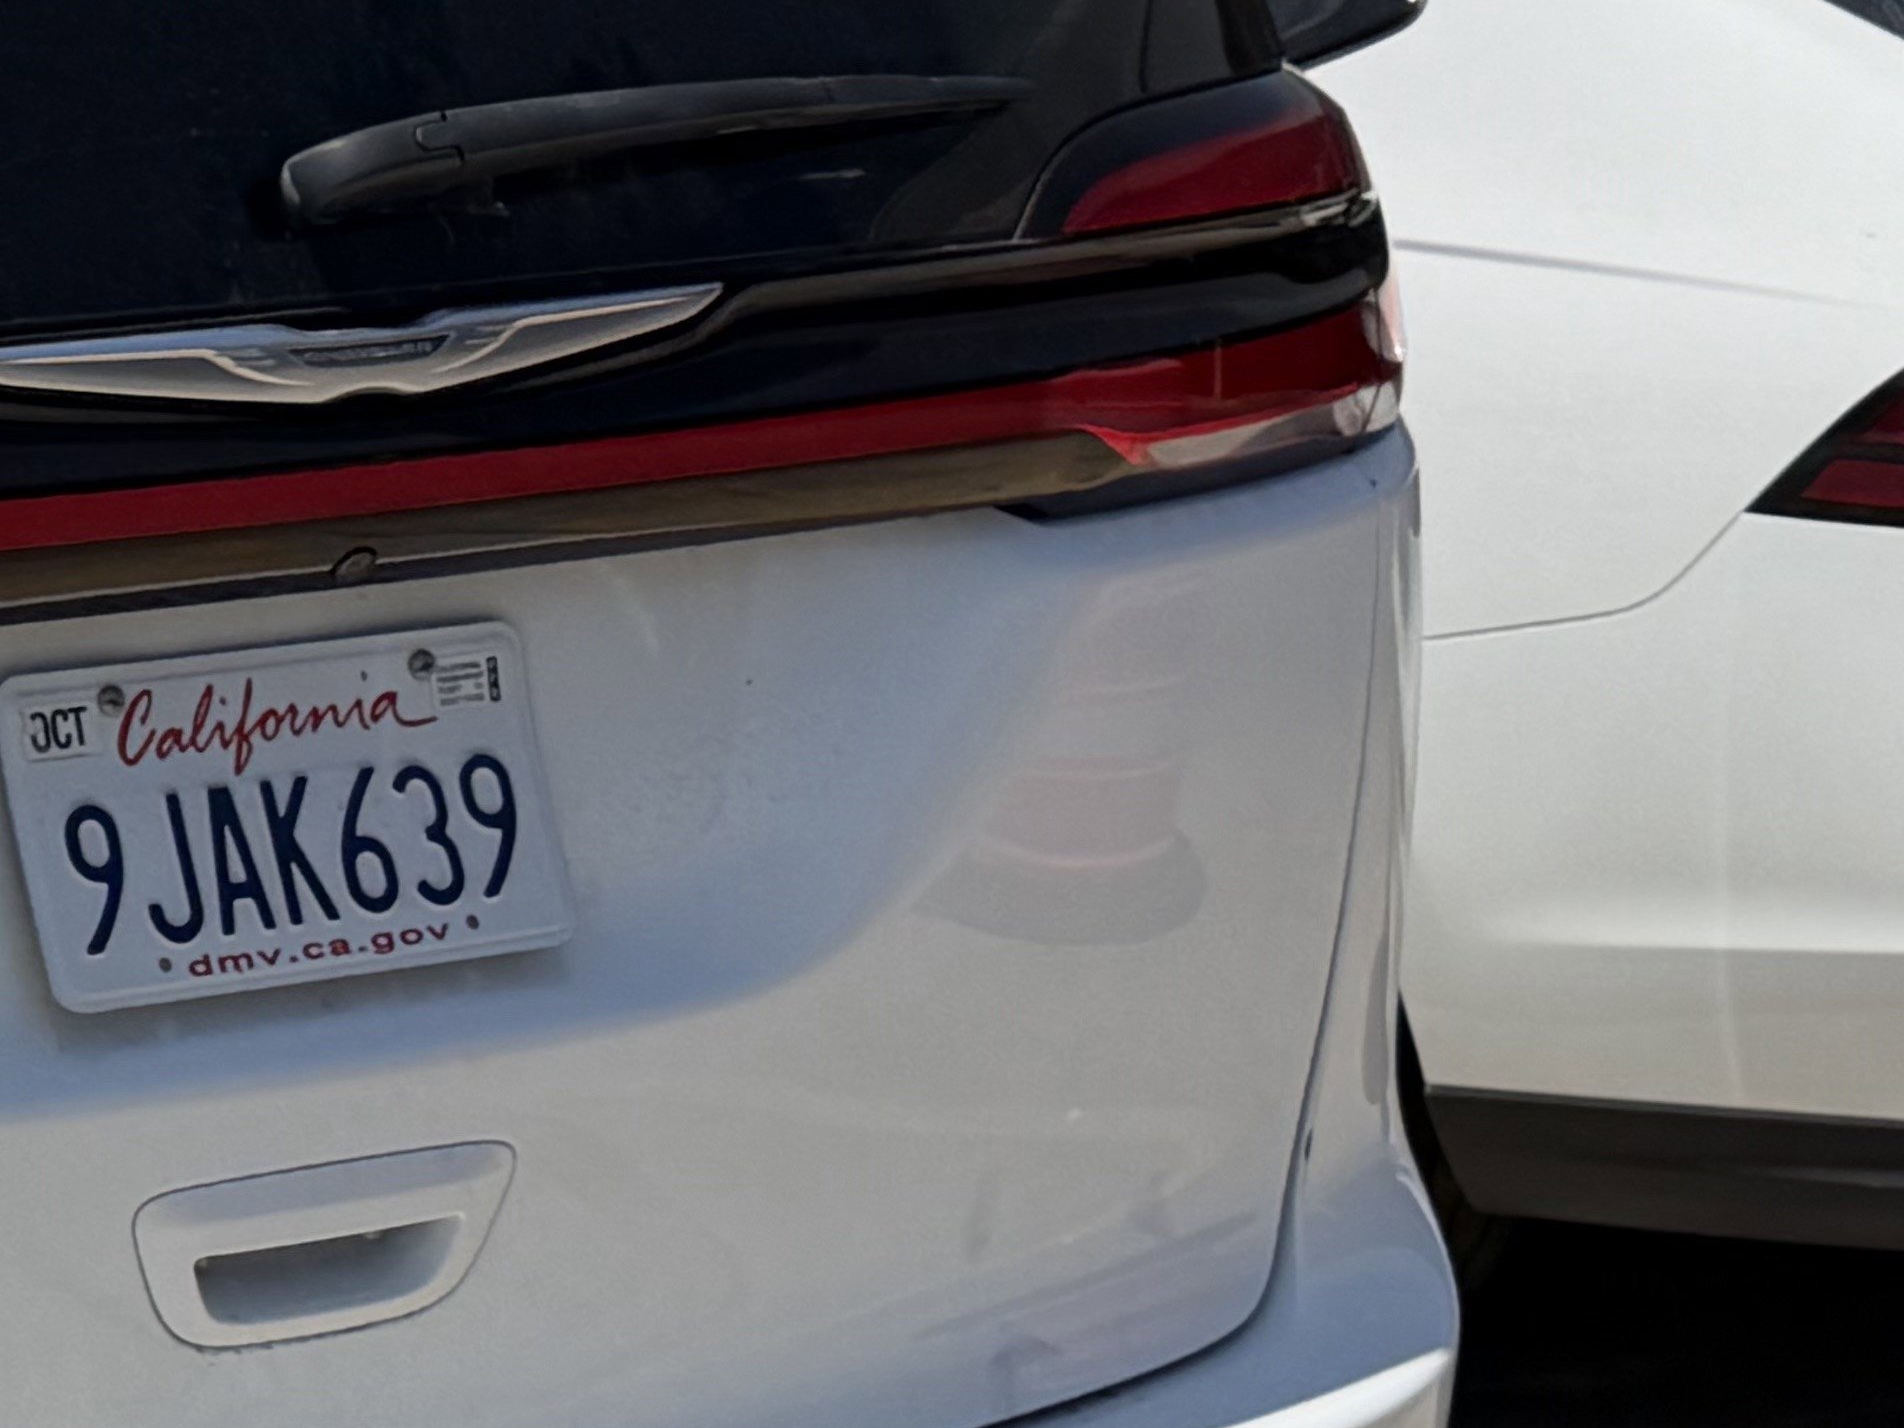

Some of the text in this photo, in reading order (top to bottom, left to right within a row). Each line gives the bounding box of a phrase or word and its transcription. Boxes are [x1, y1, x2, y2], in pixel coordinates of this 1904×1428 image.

[116, 671, 437, 775] California
[63, 753, 518, 956] 9JAK639
[188, 921, 450, 977] dmv.ca.gov
